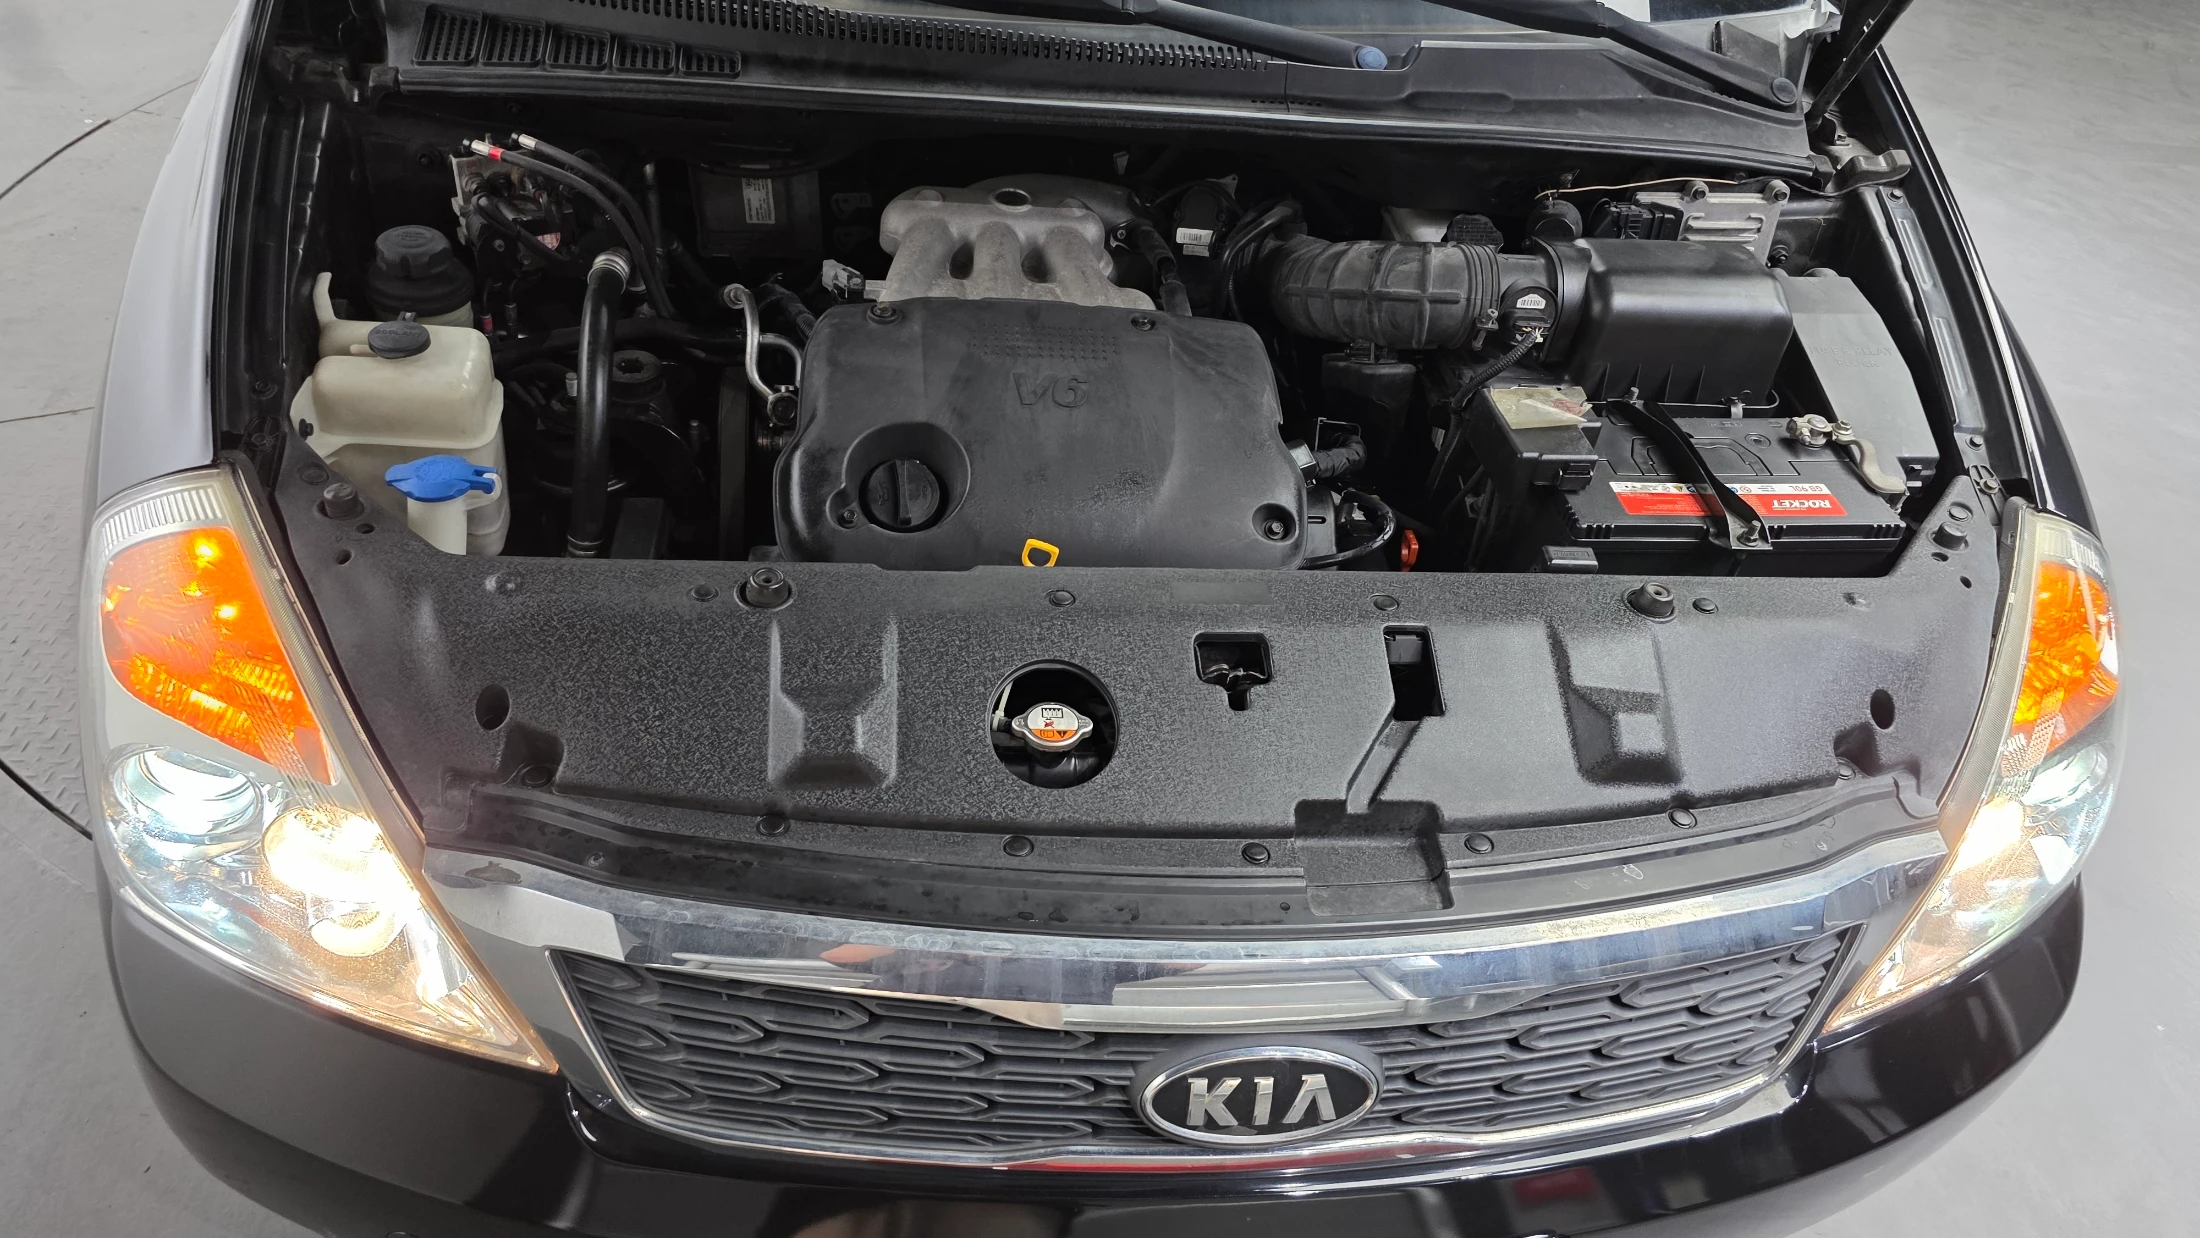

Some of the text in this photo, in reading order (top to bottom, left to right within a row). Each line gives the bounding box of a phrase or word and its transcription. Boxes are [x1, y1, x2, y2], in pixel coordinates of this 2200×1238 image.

[1809, 346, 1839, 355] FUSE
[1853, 346, 1892, 356] RELAY
[1837, 359, 1880, 368] BLOCK
[1012, 372, 1088, 409] V6
[1771, 499, 1832, 508] ROCKET
[1186, 1073, 1337, 1126] KIA
